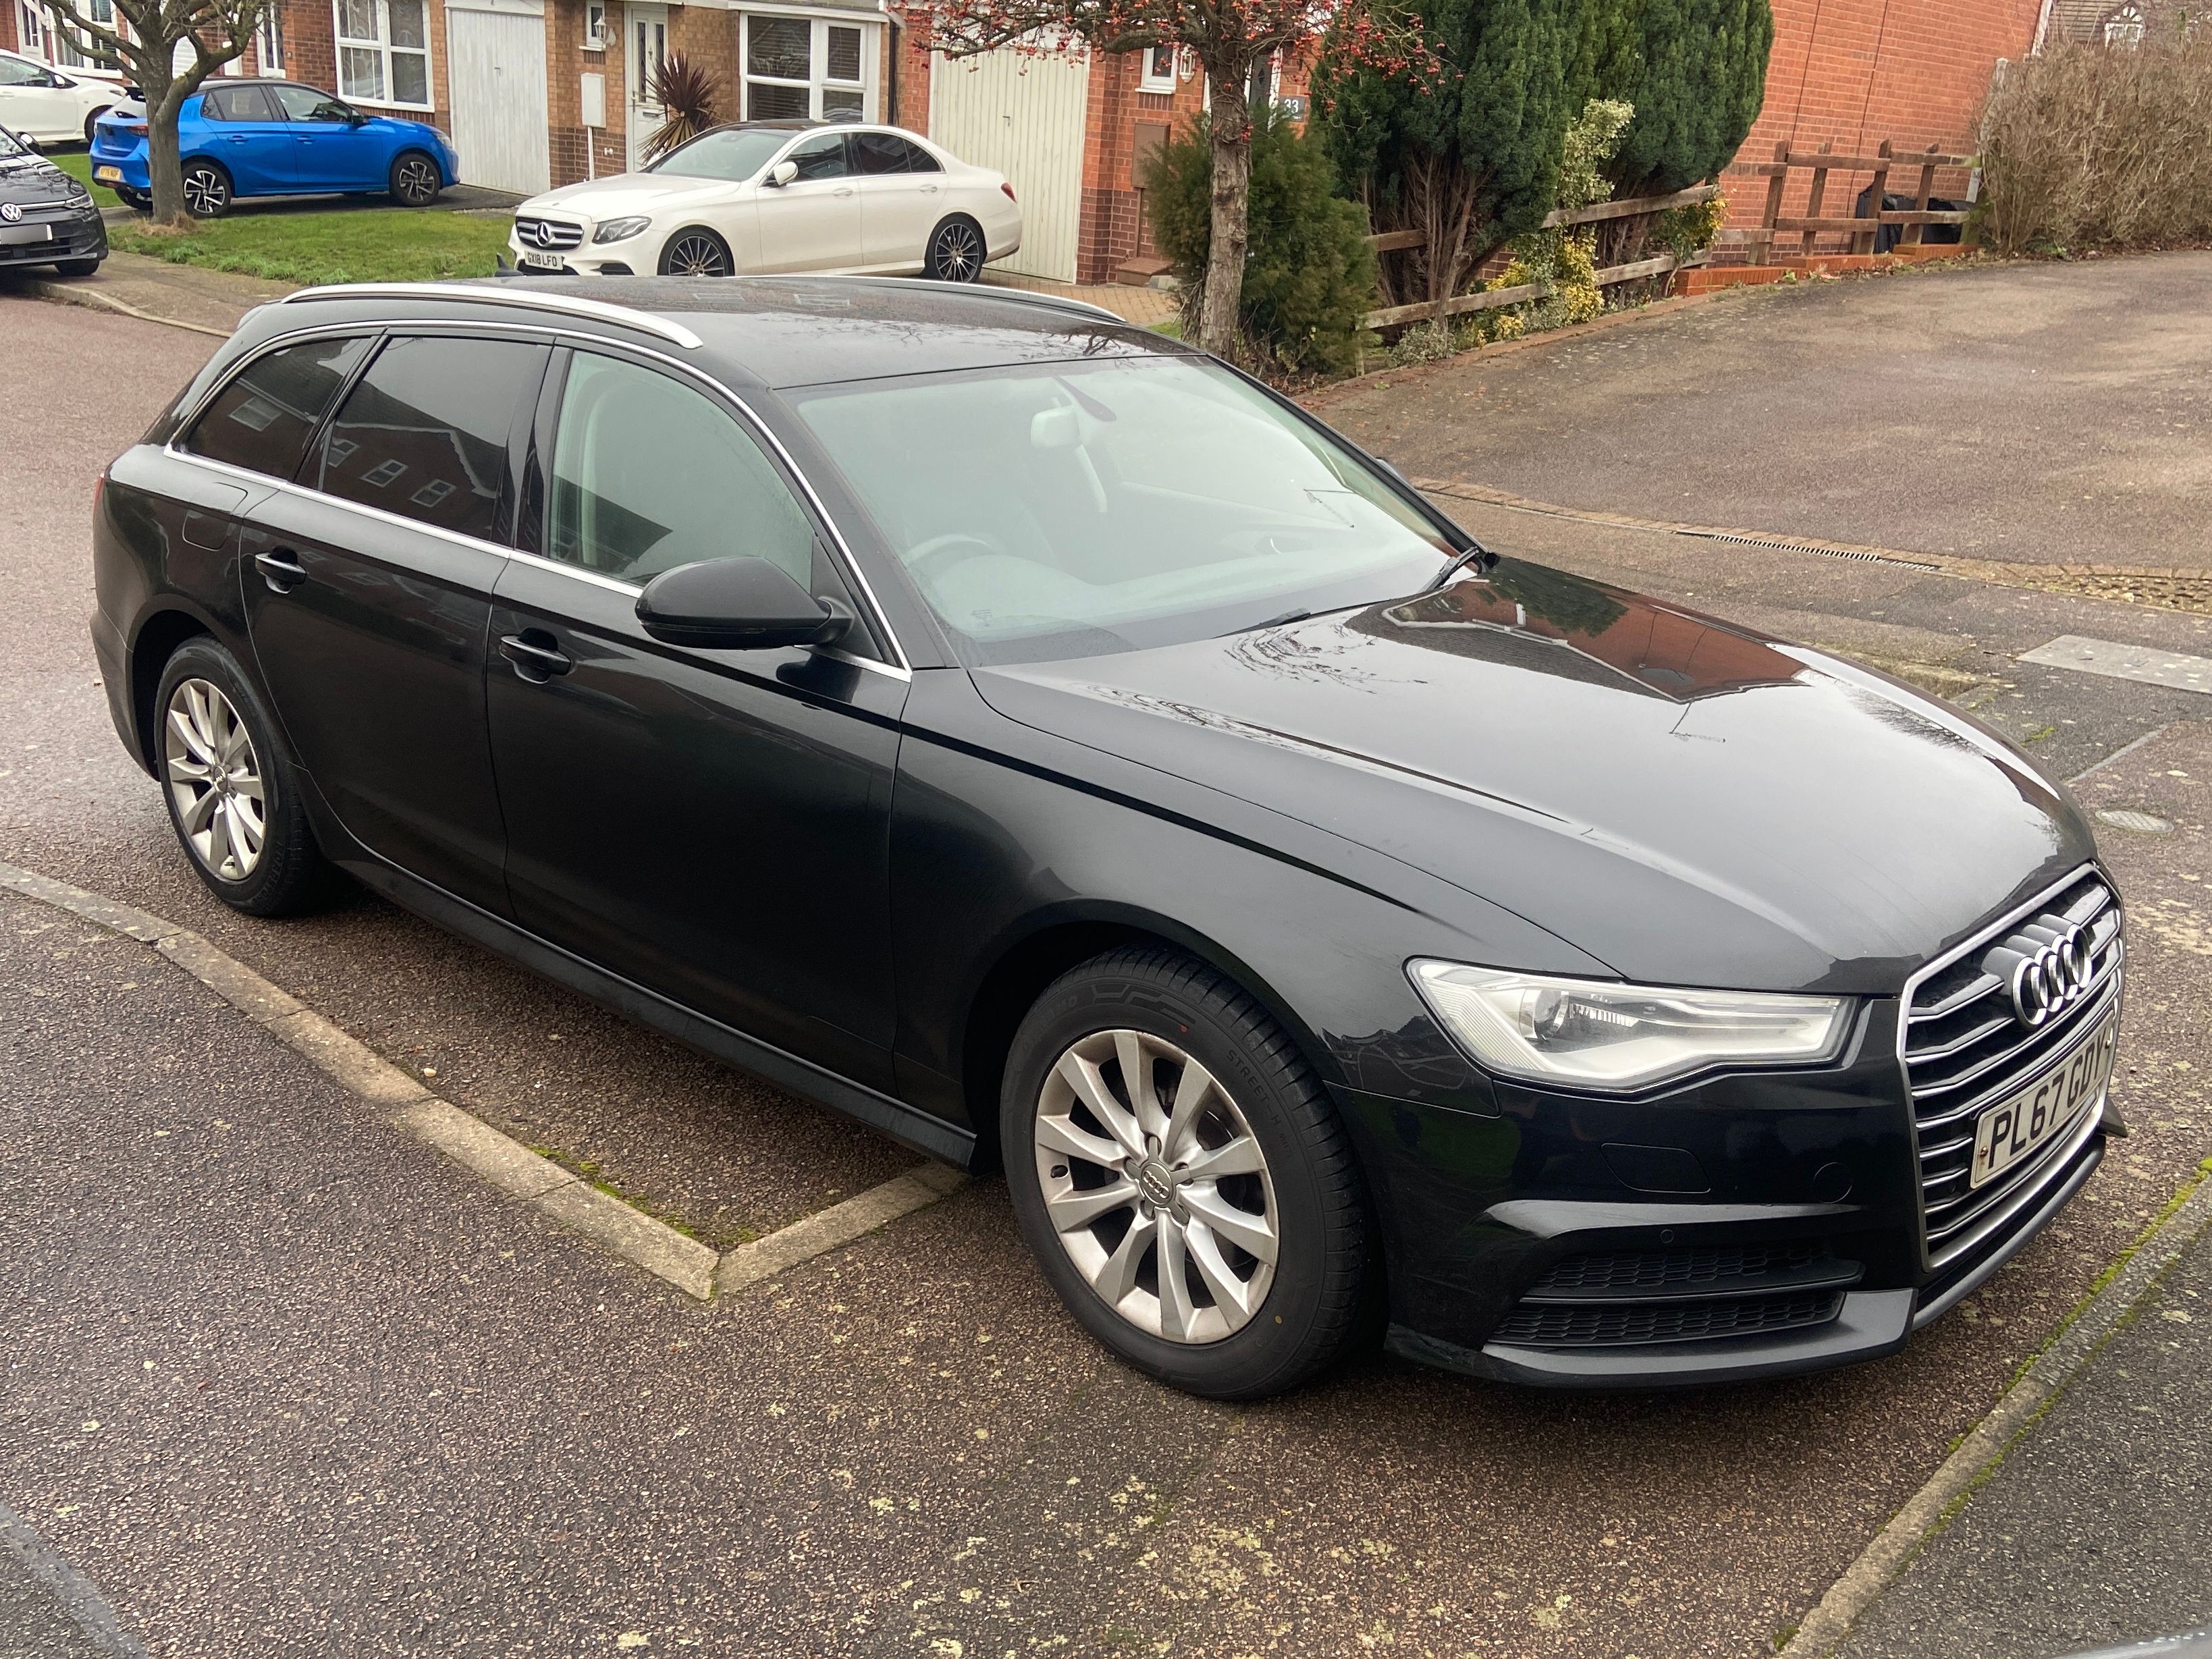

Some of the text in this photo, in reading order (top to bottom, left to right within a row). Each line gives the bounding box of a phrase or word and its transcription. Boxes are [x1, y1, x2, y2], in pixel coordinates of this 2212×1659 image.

[1284, 99, 1299, 113] 33
[2, 203, 22, 221] VW
[527, 252, 557, 267] GX18 LFO
[1226, 1050, 1281, 1124] STREET-H
[1987, 1026, 2107, 1169] PL67 GDY
